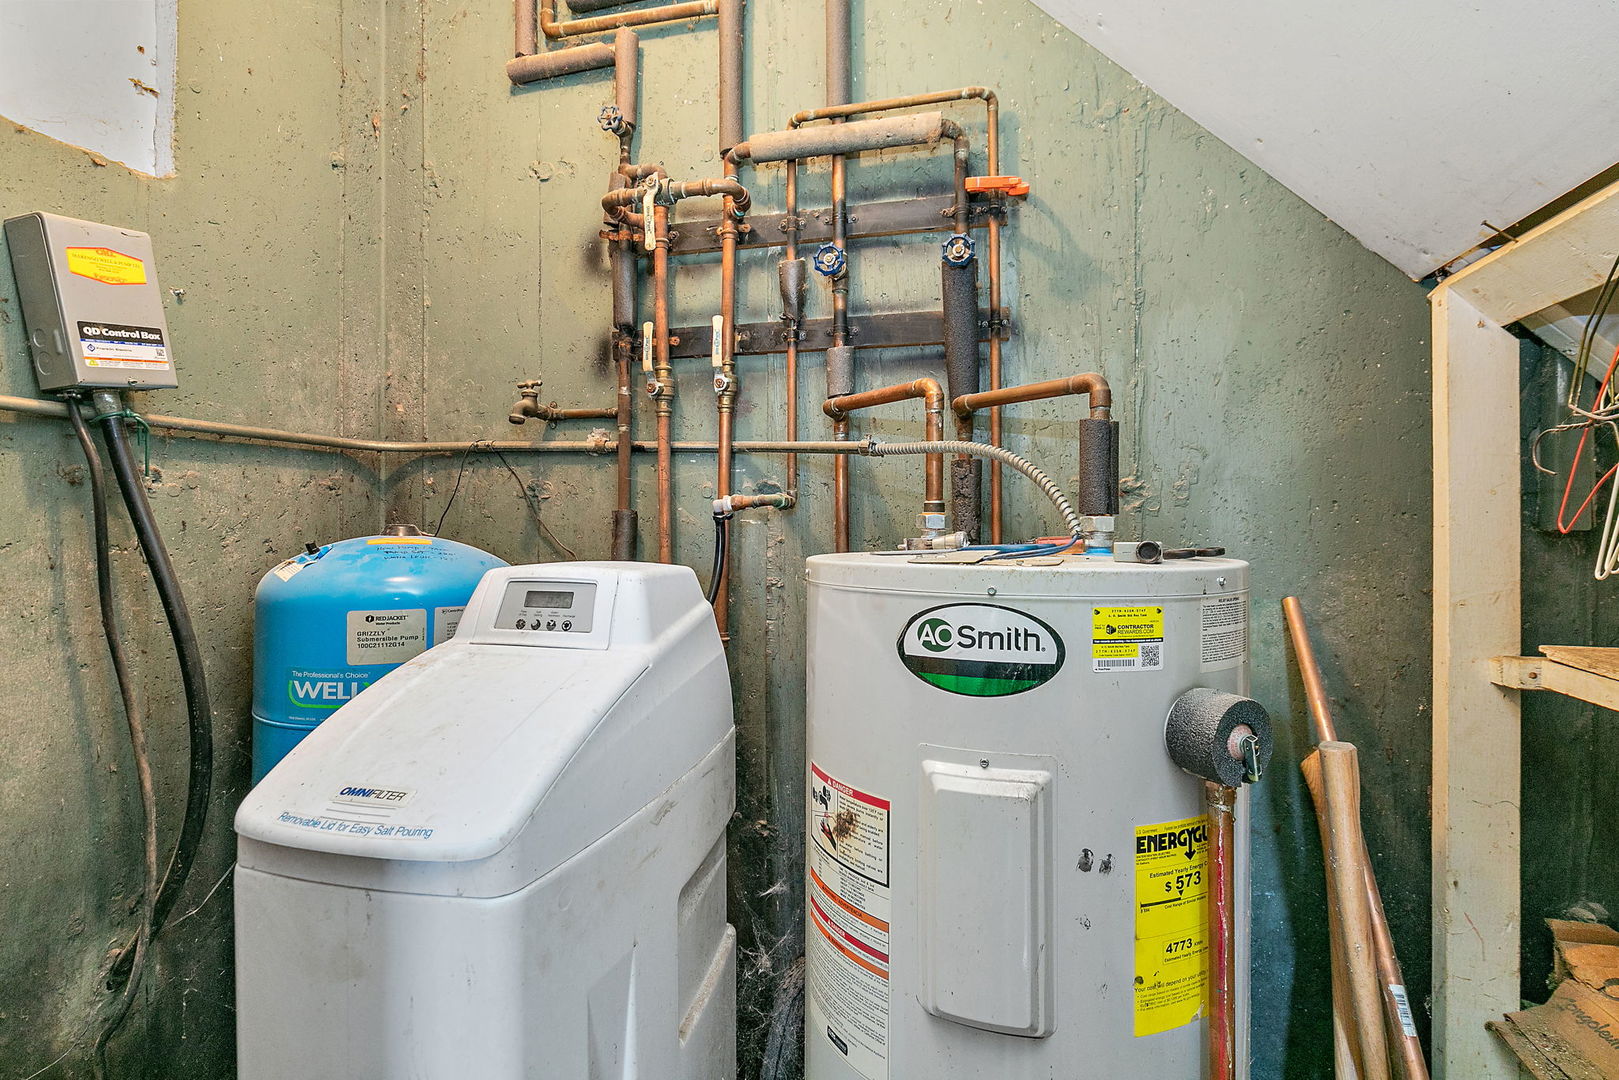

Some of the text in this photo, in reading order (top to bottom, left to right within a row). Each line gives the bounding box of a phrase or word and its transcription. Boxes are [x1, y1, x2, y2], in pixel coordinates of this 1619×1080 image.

[82, 326, 161, 340] QD Control Box
[957, 625, 1041, 652] Smith
[292, 670, 302, 678] The
[340, 787, 408, 801] OMNIFILTER
[832, 782, 854, 797] DANGER
[277, 812, 434, 839] Removable Lid for Easy Salt Pouring
[1149, 862, 1204, 879] Estimated Yearly Energy
[1165, 871, 1202, 893] $ 573
[1166, 938, 1192, 954] 4773
[1166, 978, 1182, 987] depend
